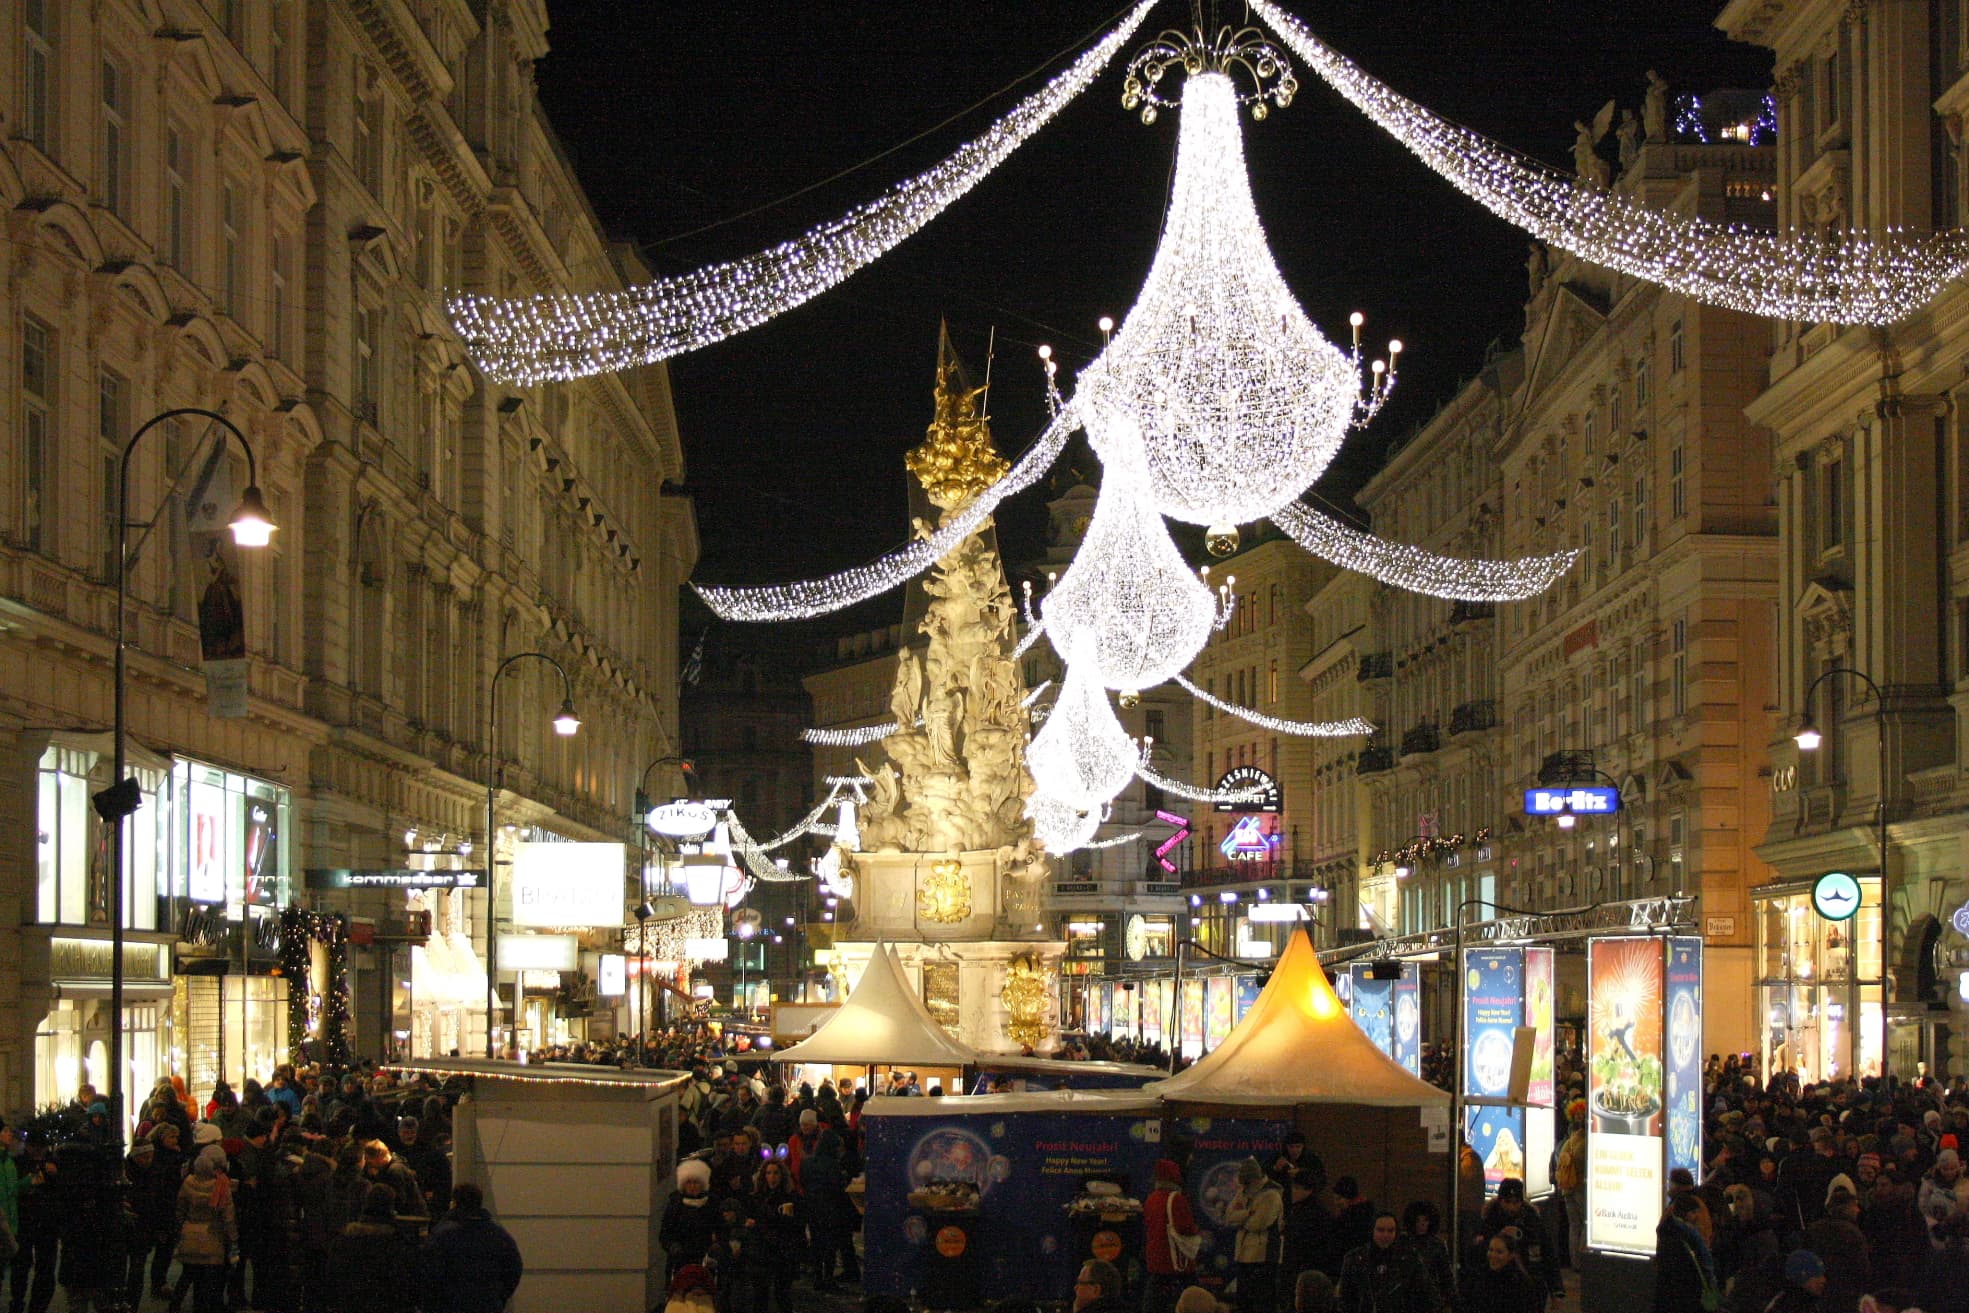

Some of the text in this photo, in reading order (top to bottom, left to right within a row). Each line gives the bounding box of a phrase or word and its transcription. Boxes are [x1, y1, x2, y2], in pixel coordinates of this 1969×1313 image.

[1535, 790, 1607, 811] Berlitz
[1227, 851, 1264, 861] CAFE
[1601, 1208, 1617, 1217] Bank
